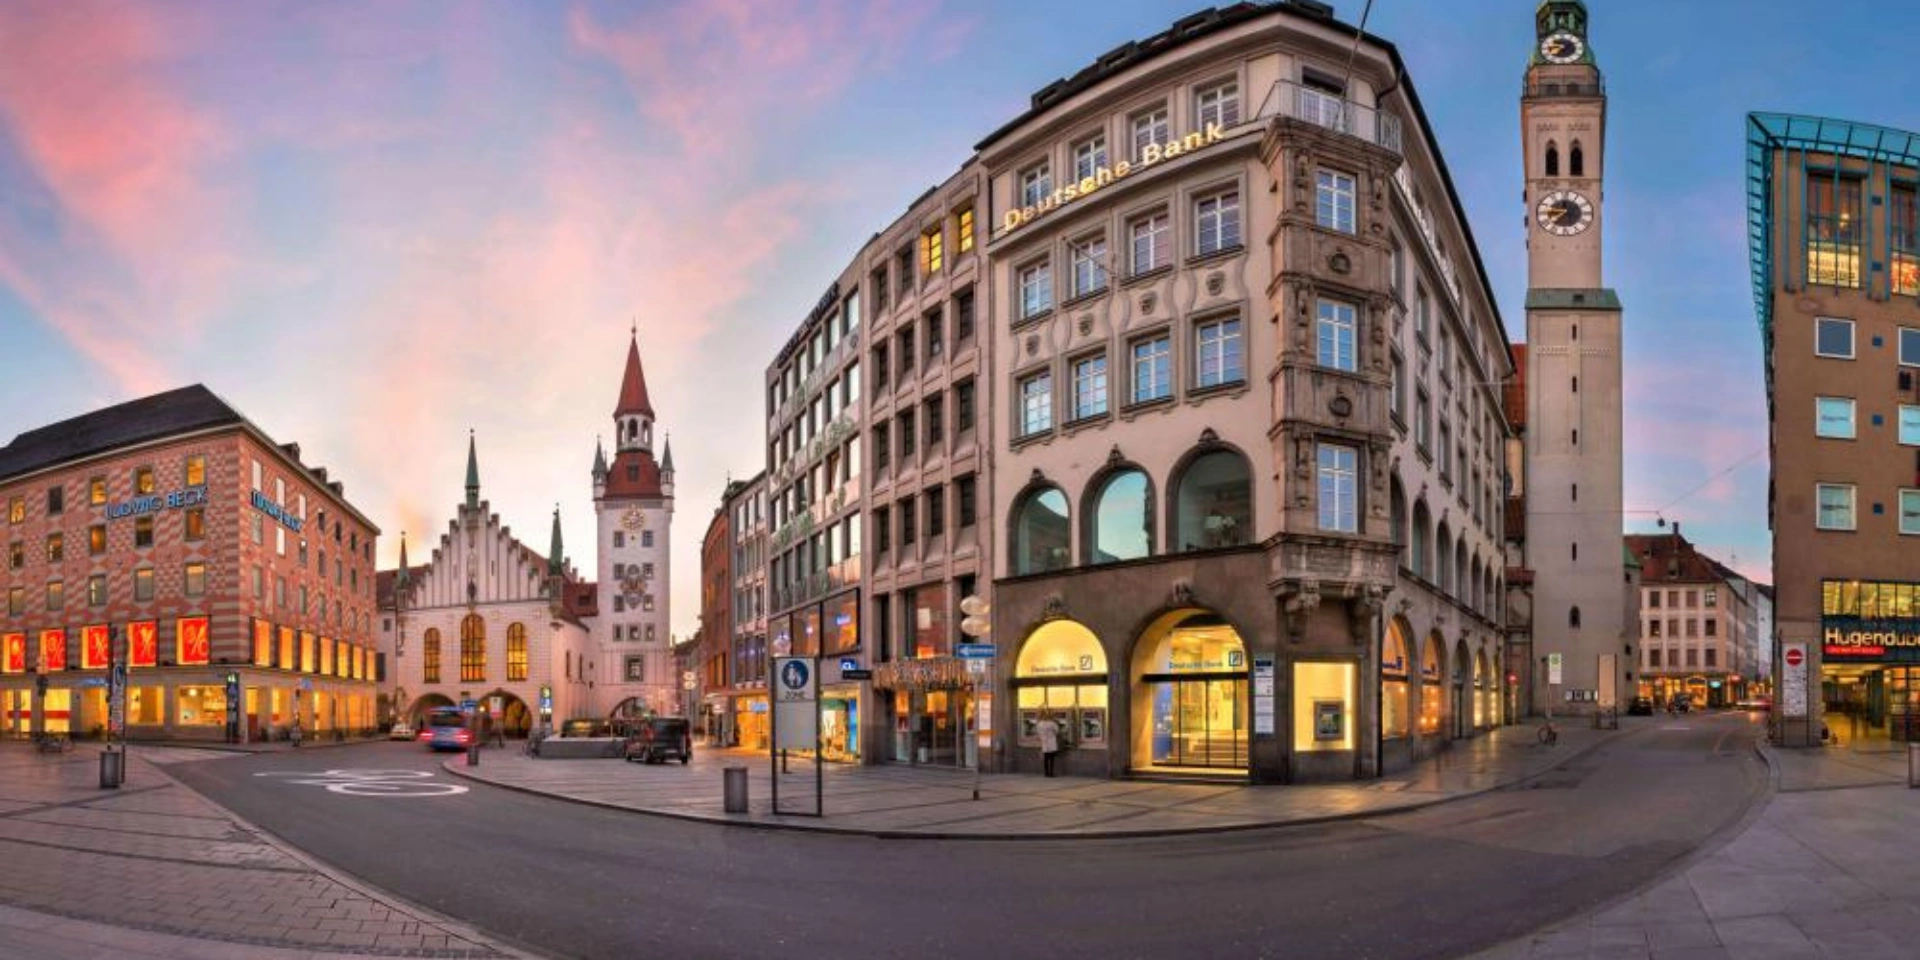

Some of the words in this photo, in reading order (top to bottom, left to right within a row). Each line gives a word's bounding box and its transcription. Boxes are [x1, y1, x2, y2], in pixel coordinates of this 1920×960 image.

[1004, 160, 1131, 232] Deutsche
[1142, 121, 1225, 166] Bank
[167, 485, 207, 508] BECK
[1825, 627, 1920, 648] Hugendub
